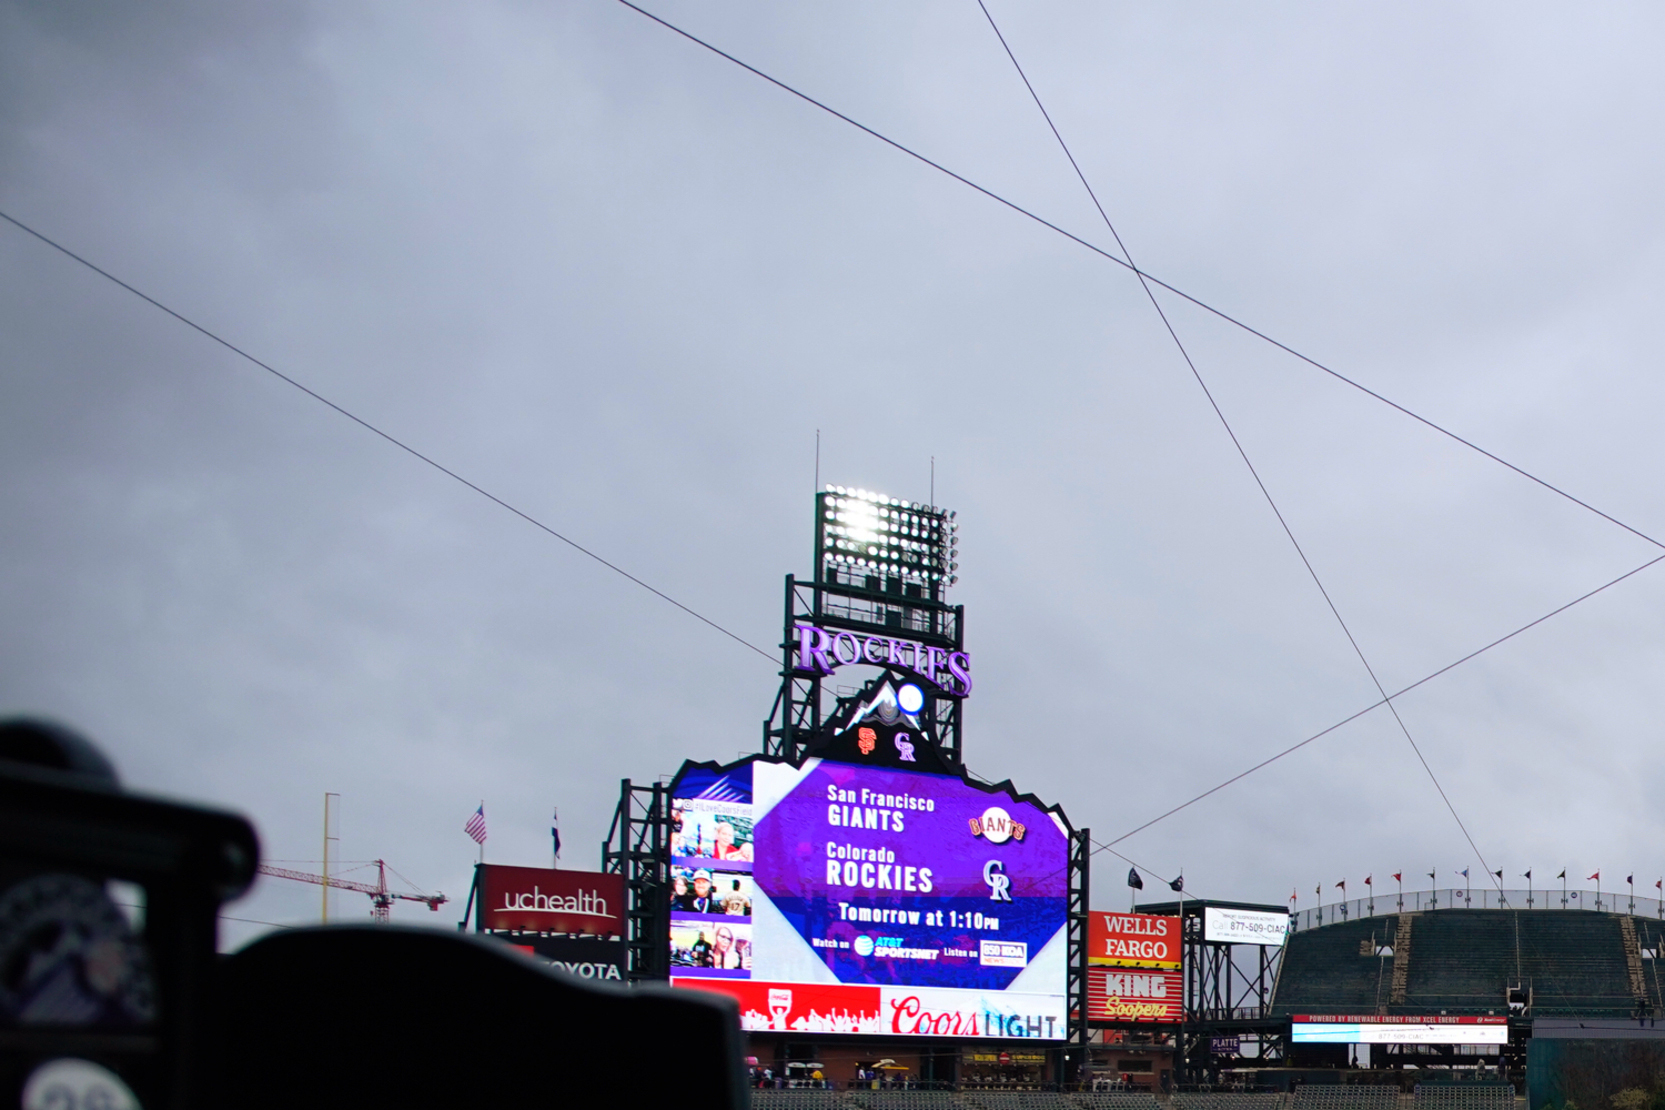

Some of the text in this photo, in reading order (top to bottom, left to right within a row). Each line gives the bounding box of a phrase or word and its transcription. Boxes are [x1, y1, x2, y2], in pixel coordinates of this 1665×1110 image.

[795, 623, 973, 699] ROCKIES
[827, 785, 936, 812] San Francisco
[828, 805, 905, 832] GIANTS
[969, 817, 1026, 840] GIANTS
[826, 841, 896, 864] Colorado
[826, 861, 933, 893] ROCKIES
[505, 885, 607, 914] uchealth
[839, 902, 922, 926] Tomorrow
[926, 909, 944, 927] at
[1103, 916, 1167, 936] WELLS
[1230, 921, 1286, 935] 877-509-CIAC
[812, 937, 850, 949] Watch on
[875, 936, 904, 947] AT&T
[944, 947, 968, 958] Listen
[1104, 938, 1168, 959] FARGO
[874, 947, 940, 960] SPORTSNET
[541, 960, 622, 980] OYOTA
[1105, 974, 1167, 998] KING
[893, 996, 1058, 1038] Coors LIGHT
[1103, 996, 1168, 1022] Soopers
[1382, 1015, 1403, 1023] ENERGY
[1212, 1038, 1239, 1048] PLATTE
